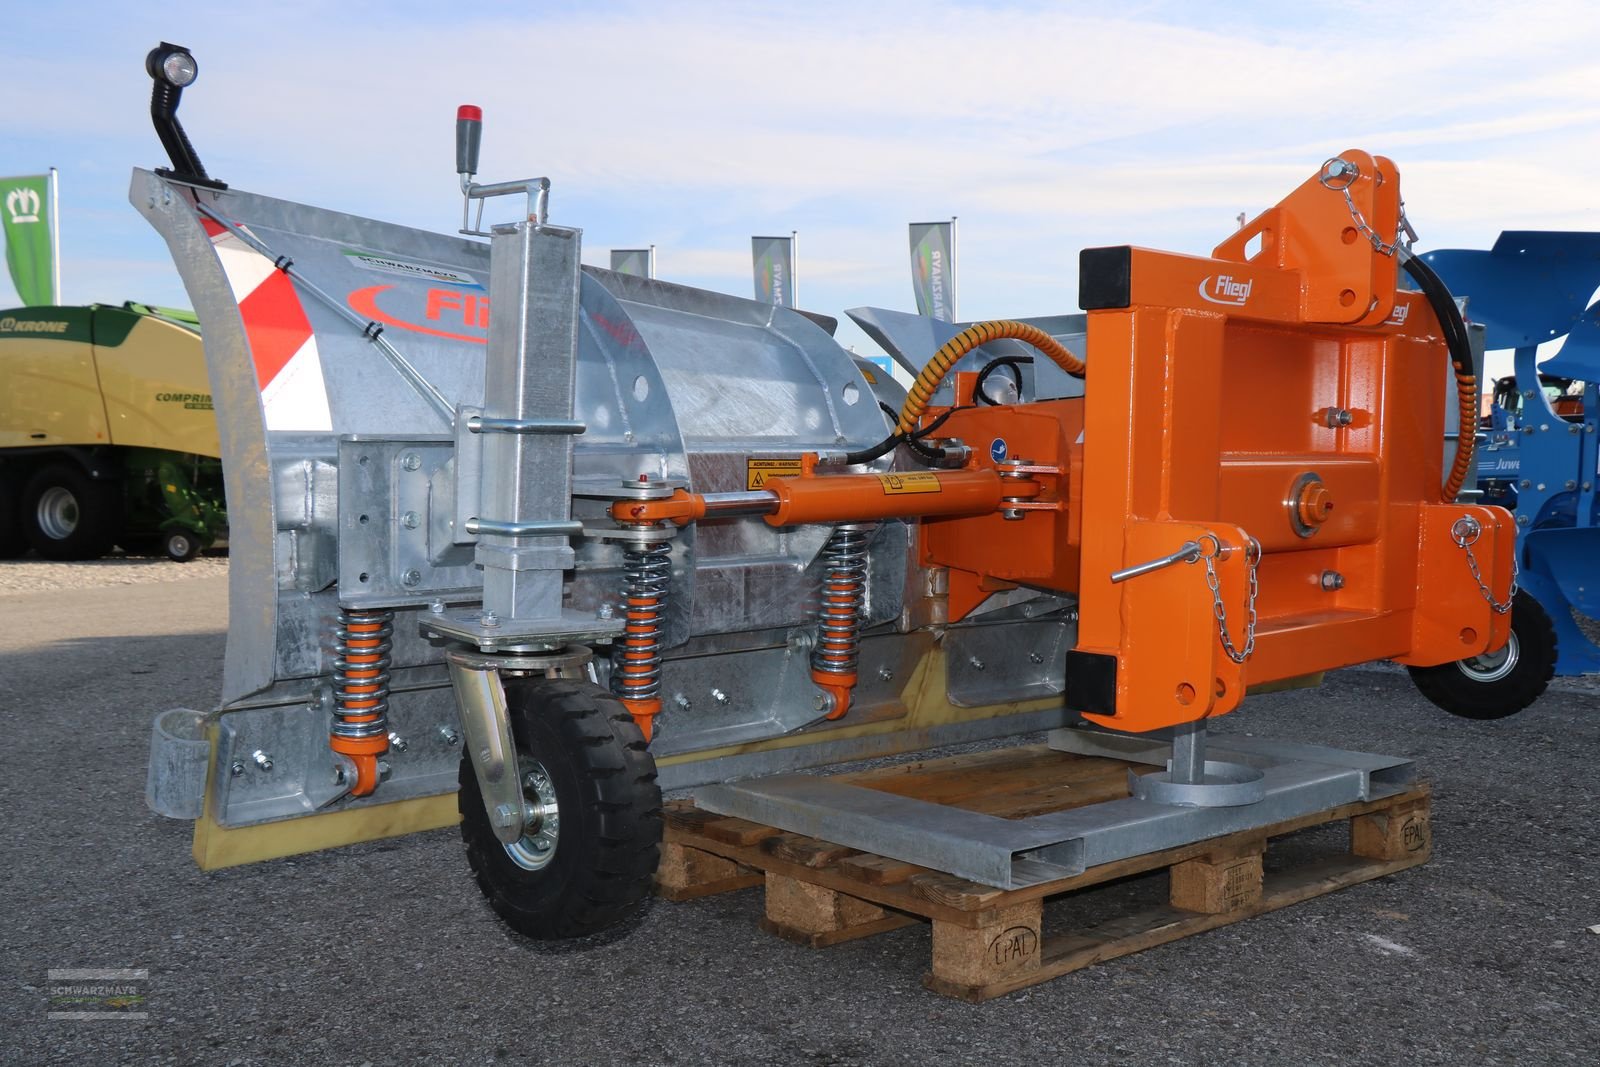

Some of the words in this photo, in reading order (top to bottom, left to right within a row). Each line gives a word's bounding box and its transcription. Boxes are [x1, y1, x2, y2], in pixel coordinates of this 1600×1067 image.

[1215, 275, 1253, 302] Fliegl
[425, 287, 490, 329] Fli
[1392, 302, 1410, 322] egl
[15, 320, 69, 333] KRONE
[1404, 822, 1425, 845] EPAL
[995, 934, 1029, 965] EPAL
